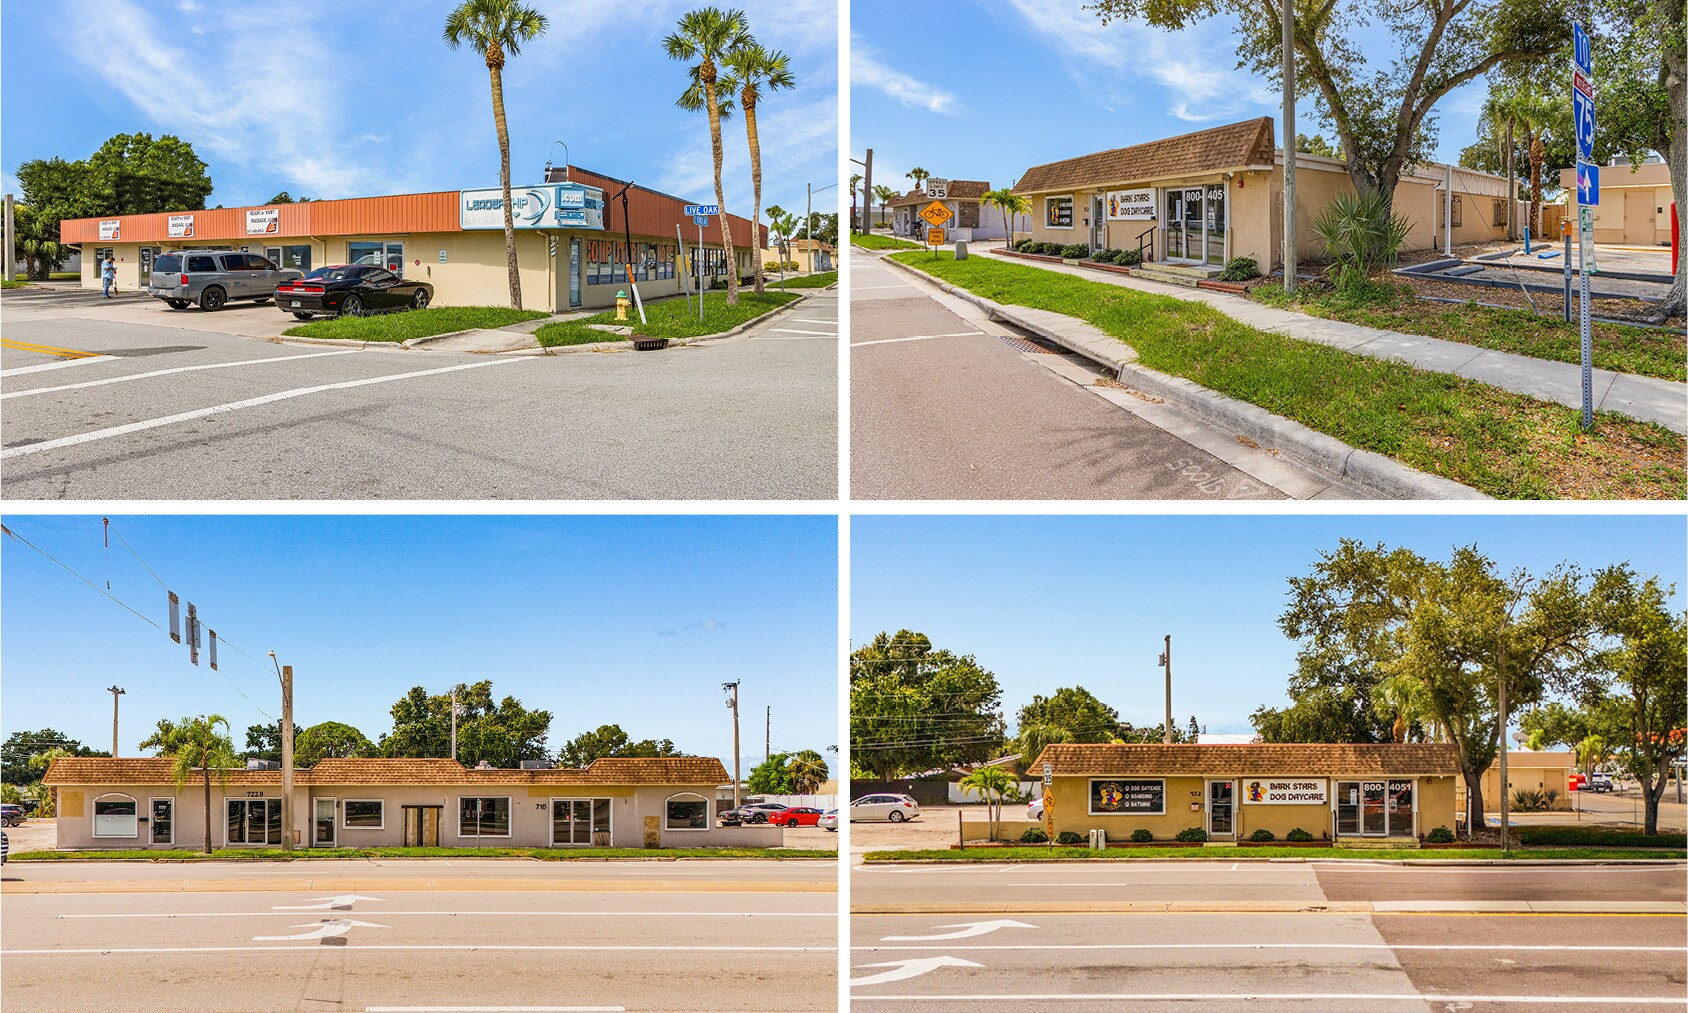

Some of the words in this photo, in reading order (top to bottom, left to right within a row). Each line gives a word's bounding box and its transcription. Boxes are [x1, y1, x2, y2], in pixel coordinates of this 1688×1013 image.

[1577, 31, 1588, 68] TO
[1576, 92, 1593, 145] 75
[929, 189, 945, 198] 35
[1120, 194, 1133, 203] BARK
[1133, 193, 1150, 203] STARS
[466, 197, 528, 210] LEADERHIP
[562, 194, 583, 203] .com
[685, 206, 700, 214] LIVE
[703, 206, 718, 214] OAK
[1120, 207, 1130, 216] DOG
[1131, 206, 1154, 216] DAYCARE
[1269, 782, 1291, 790] BARK
[1292, 782, 1318, 790] STARS
[1389, 783, 1412, 791] 4051
[1269, 793, 1286, 801] DOG
[1288, 793, 1324, 801] DAYCARE
